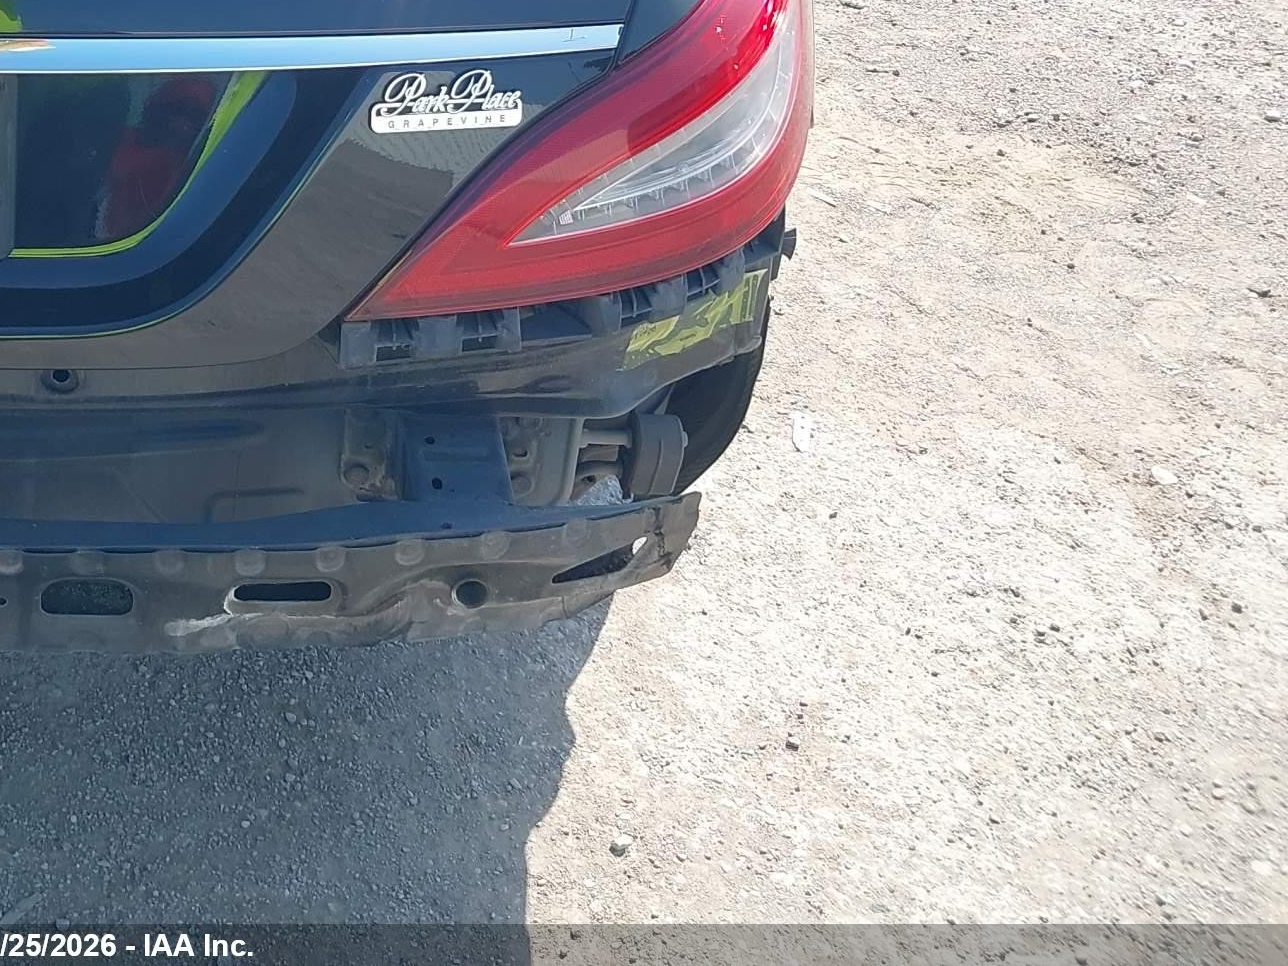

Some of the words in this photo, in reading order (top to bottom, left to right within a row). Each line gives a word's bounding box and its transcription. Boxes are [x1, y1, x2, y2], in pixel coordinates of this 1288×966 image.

[380, 73, 449, 116] Park
[447, 69, 521, 114] Place
[388, 114, 506, 129] GRAPEVINE
